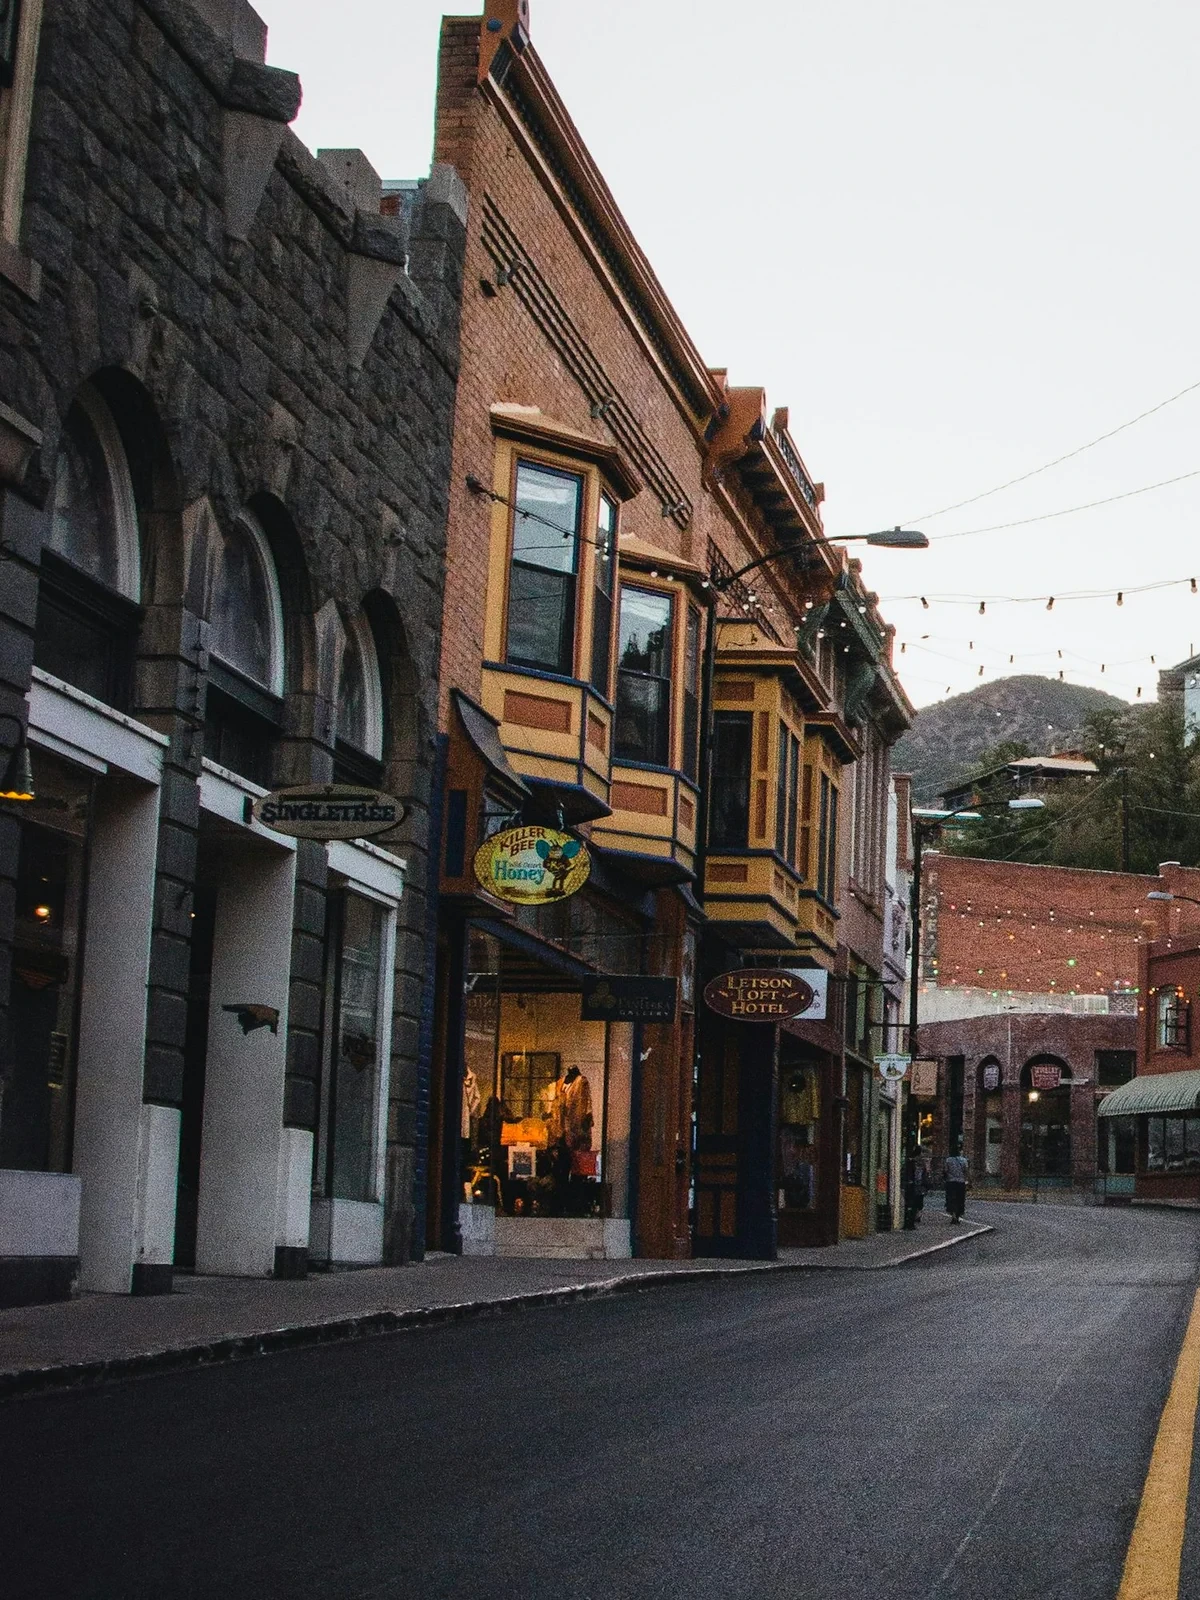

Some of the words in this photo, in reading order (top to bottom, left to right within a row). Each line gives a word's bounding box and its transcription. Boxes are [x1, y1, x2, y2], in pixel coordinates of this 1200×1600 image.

[260, 802, 396, 823] SINGLETREE
[500, 827, 547, 852] KILLER
[510, 839, 536, 857] BEE
[494, 860, 545, 885] Honey
[727, 975, 793, 990] LETSON
[737, 988, 779, 1001] LOFT
[731, 1001, 789, 1015] HOTEL
